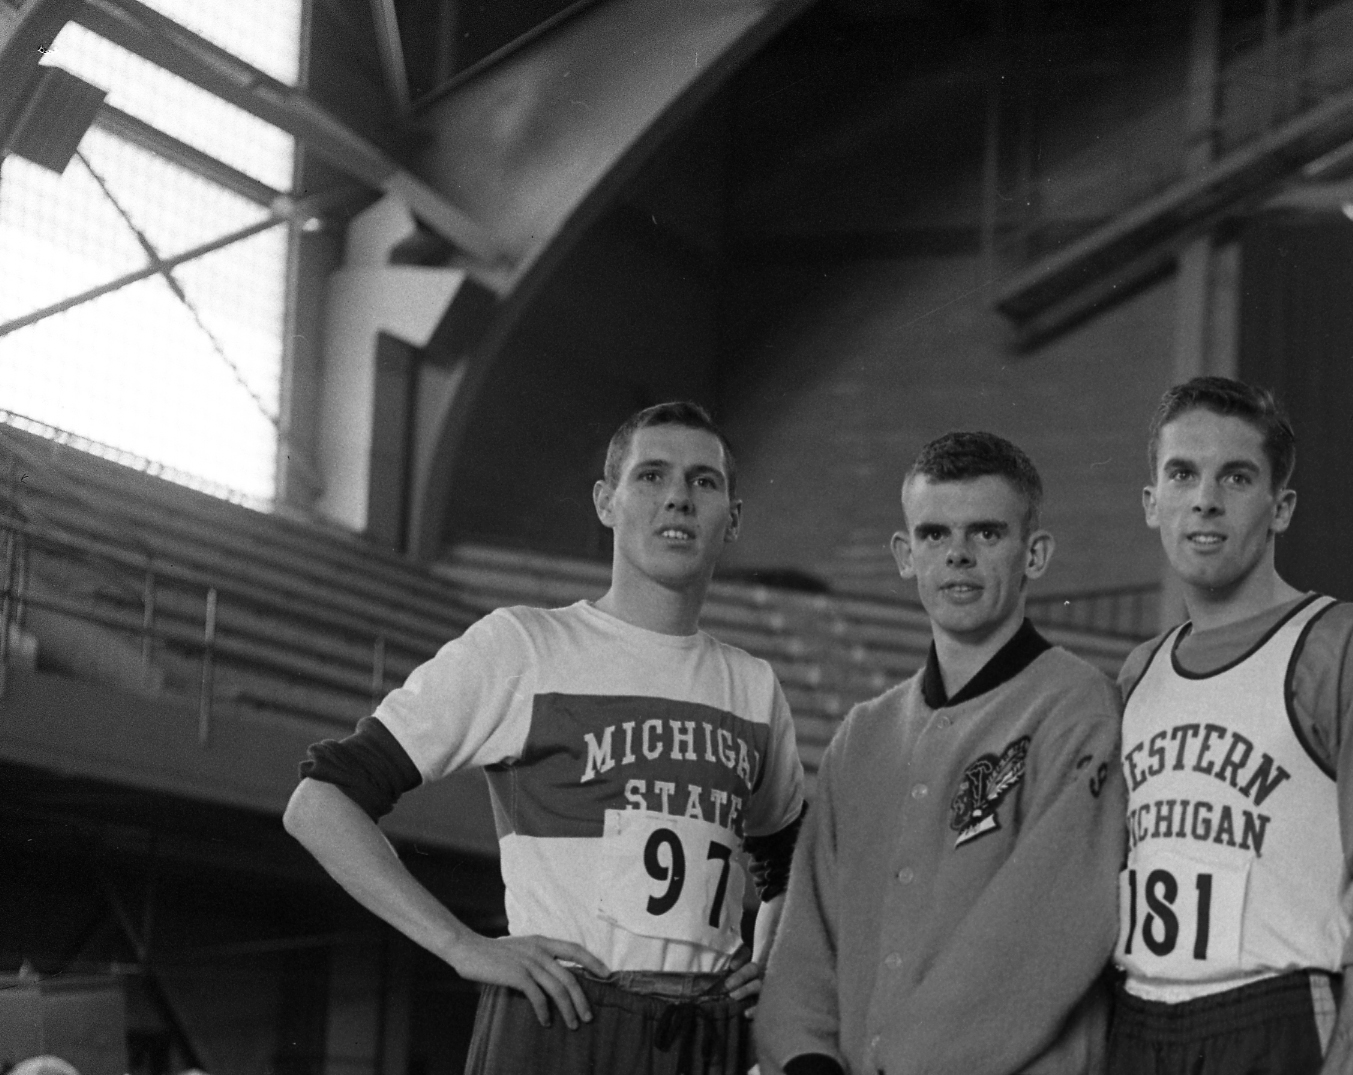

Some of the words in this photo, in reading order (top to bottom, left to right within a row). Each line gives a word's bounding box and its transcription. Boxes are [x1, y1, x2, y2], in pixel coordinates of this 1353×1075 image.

[581, 719, 759, 790] MICHIGA
[1123, 723, 1291, 807] ESTERN
[1126, 799, 1271, 858] ICHIGAN
[644, 828, 732, 929] 97
[1124, 869, 1212, 960] 181
